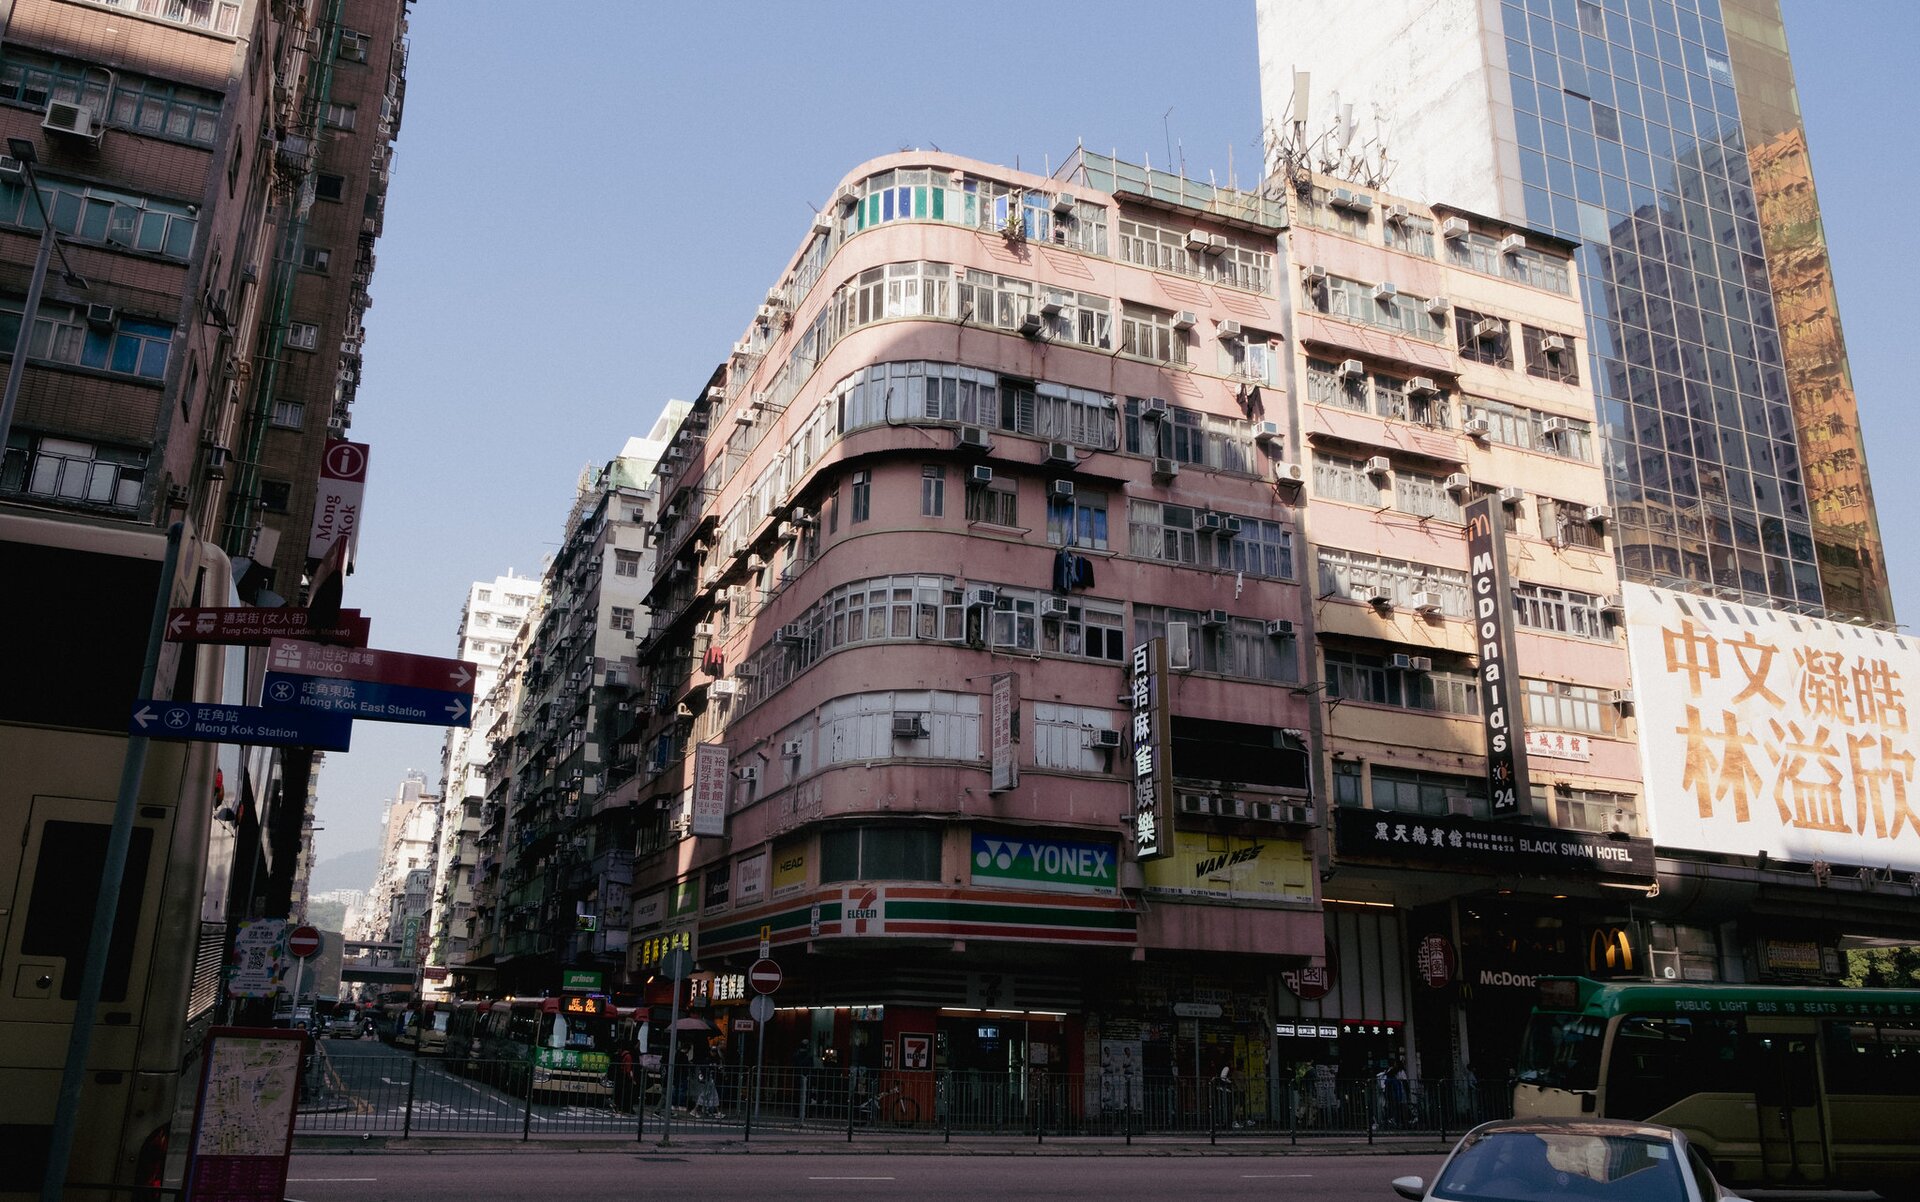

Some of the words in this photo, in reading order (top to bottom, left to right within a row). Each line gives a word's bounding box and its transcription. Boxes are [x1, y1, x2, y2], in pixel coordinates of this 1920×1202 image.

[316, 495, 341, 541] Mong
[337, 504, 356, 536] Kok
[223, 612, 260, 625] 通菜街
[262, 612, 308, 626] (女人街)
[221, 627, 242, 637] Tung
[243, 627, 262, 636] Choi
[263, 627, 286, 636] Street
[288, 627, 318, 637] (Ladies
[308, 646, 375, 666] 新世紀廣場
[1472, 552, 1508, 752] McDonald's
[306, 661, 343, 673] MOKO
[302, 681, 356, 699] 旺角東站
[197, 708, 239, 722] 旺角站
[300, 696, 331, 710] Mong
[335, 698, 357, 710] Kok
[360, 701, 384, 714] East
[387, 703, 426, 718] Station
[195, 723, 228, 736] Mong
[231, 724, 254, 736] Kok
[257, 726, 298, 738] Station
[1133, 643, 1156, 845] 百搭麻雀娛樂
[699, 755, 712, 800] 西班牙賓館
[712, 756, 726, 802] 裕家賓館
[1676, 703, 1920, 840] 林溢欣
[1494, 788, 1516, 809] 24
[1375, 821, 1463, 848] 黑天鵝賓館
[1029, 843, 1108, 879] YONEX
[1520, 839, 1557, 854] BLACK
[1561, 843, 1593, 858] SWAN
[1597, 846, 1633, 862] HOTEL
[780, 857, 803, 873] HEAD
[1196, 854, 1228, 878] WAN
[849, 887, 877, 933] 7
[571, 974, 595, 984] prince
[1480, 969, 1537, 988] McDona
[1675, 1000, 1712, 1011] PUBLIC
[1719, 1000, 1749, 1011] LIGHT
[1757, 1001, 1777, 1012] BUS
[1785, 1002, 1796, 1012] 19
[1803, 1002, 1837, 1013] SEATS
[1845, 1004, 1920, 1015] 公共小型巴
